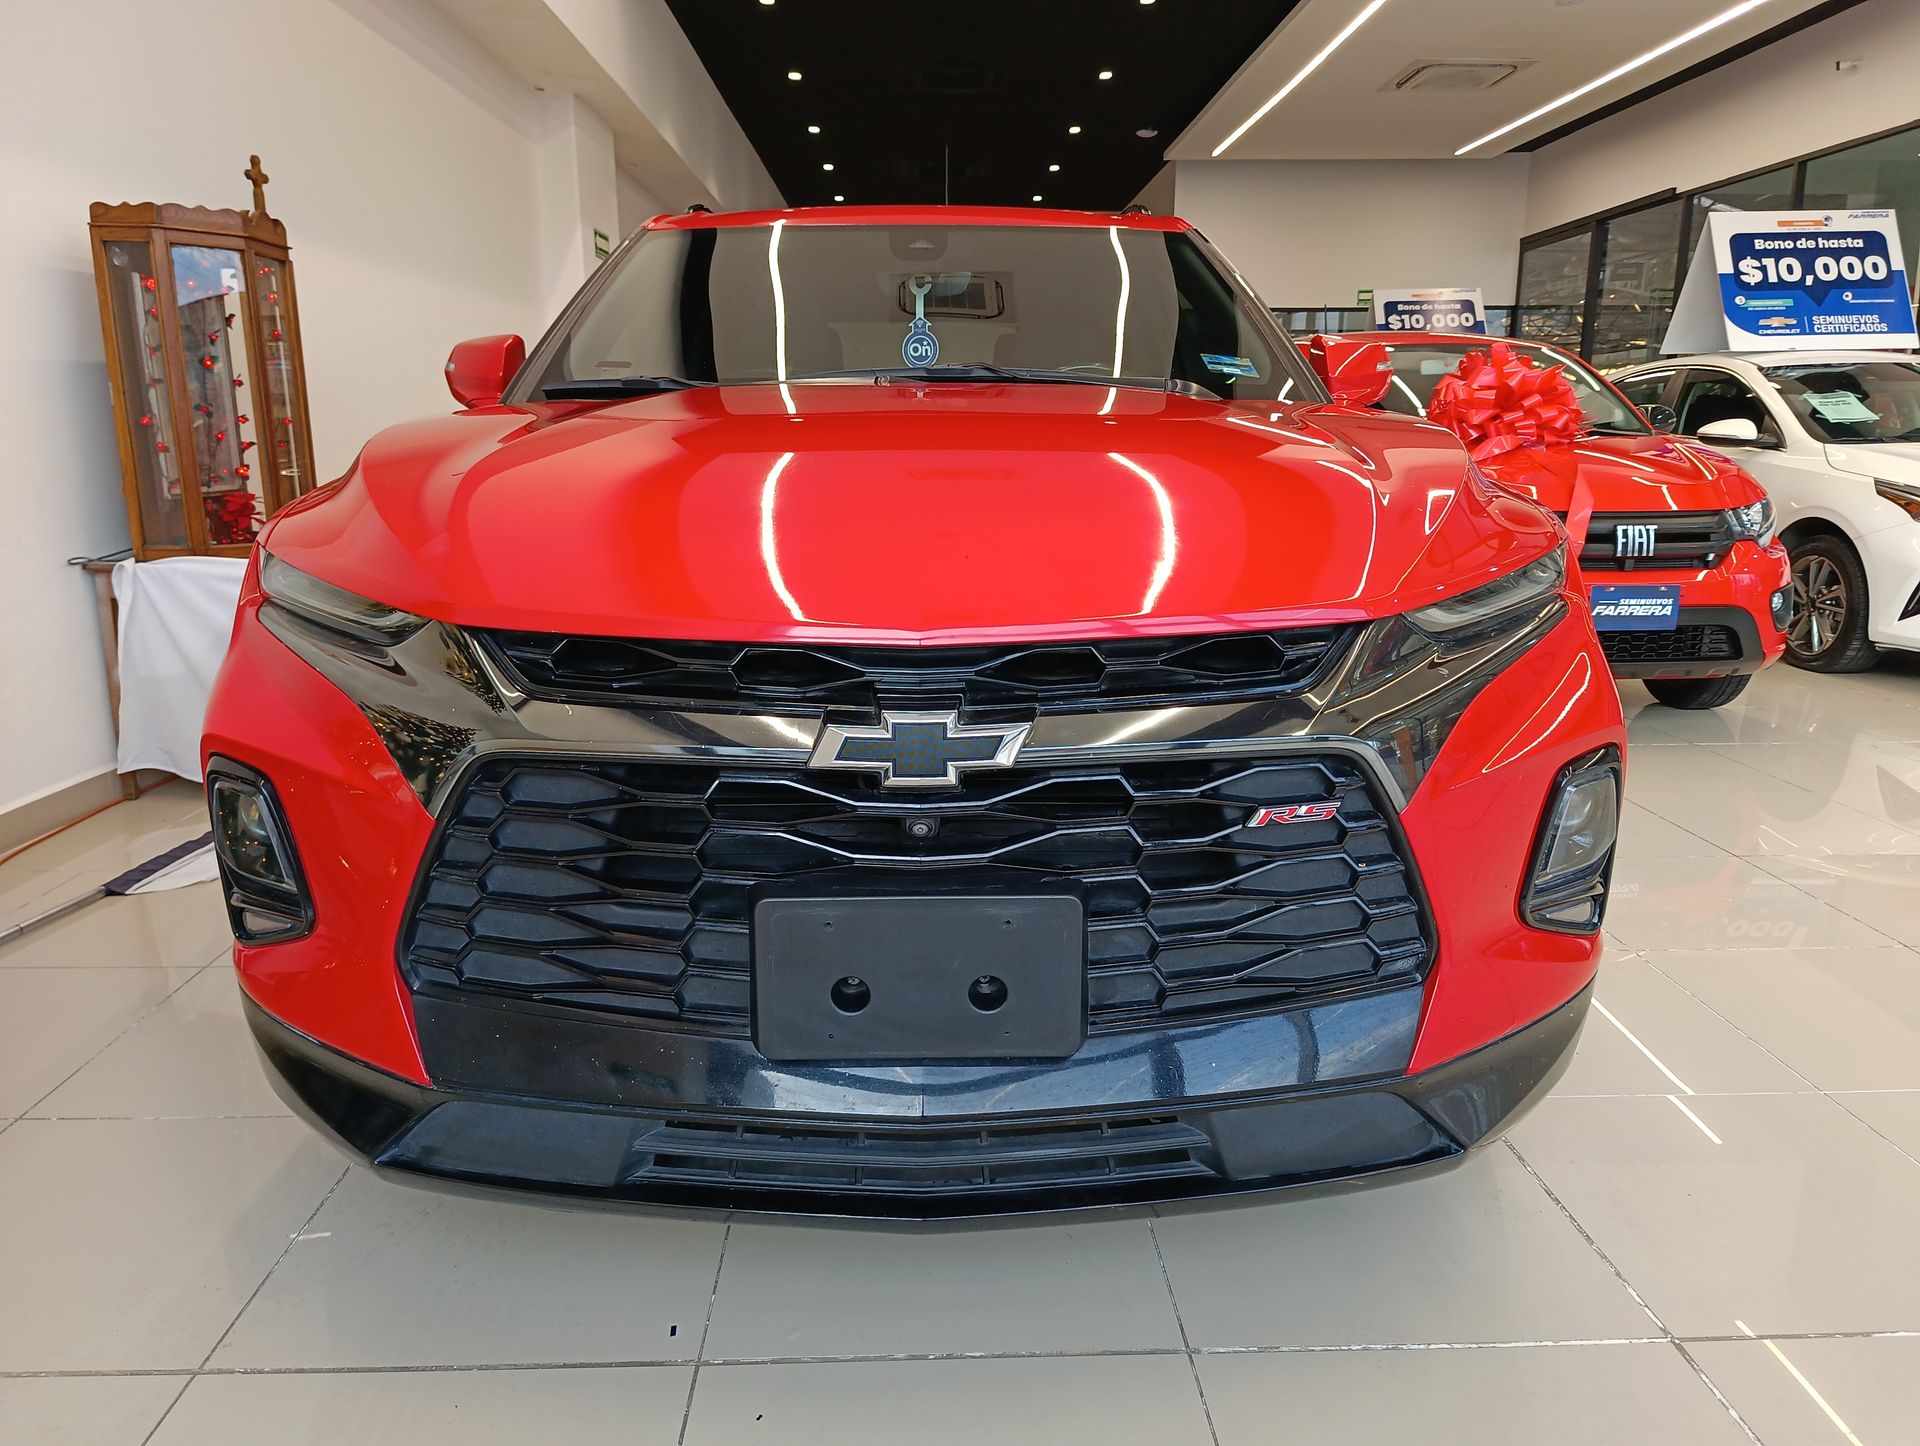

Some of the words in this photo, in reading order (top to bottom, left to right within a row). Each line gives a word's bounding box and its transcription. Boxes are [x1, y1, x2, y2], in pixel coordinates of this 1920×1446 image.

[1754, 239, 1794, 250] Bono
[1796, 238, 1816, 249] de
[1818, 237, 1864, 248] hasta
[1738, 255, 1888, 286] $10,000
[1387, 313, 1475, 330] $10,000
[1812, 315, 1880, 324] SEMINUEVOS
[1813, 323, 1888, 333] CERTIFICADOS
[909, 341, 931, 357] On
[1616, 525, 1658, 557] FIAT
[1591, 605, 1673, 616] FARRERA
[1246, 801, 1341, 828] RS
